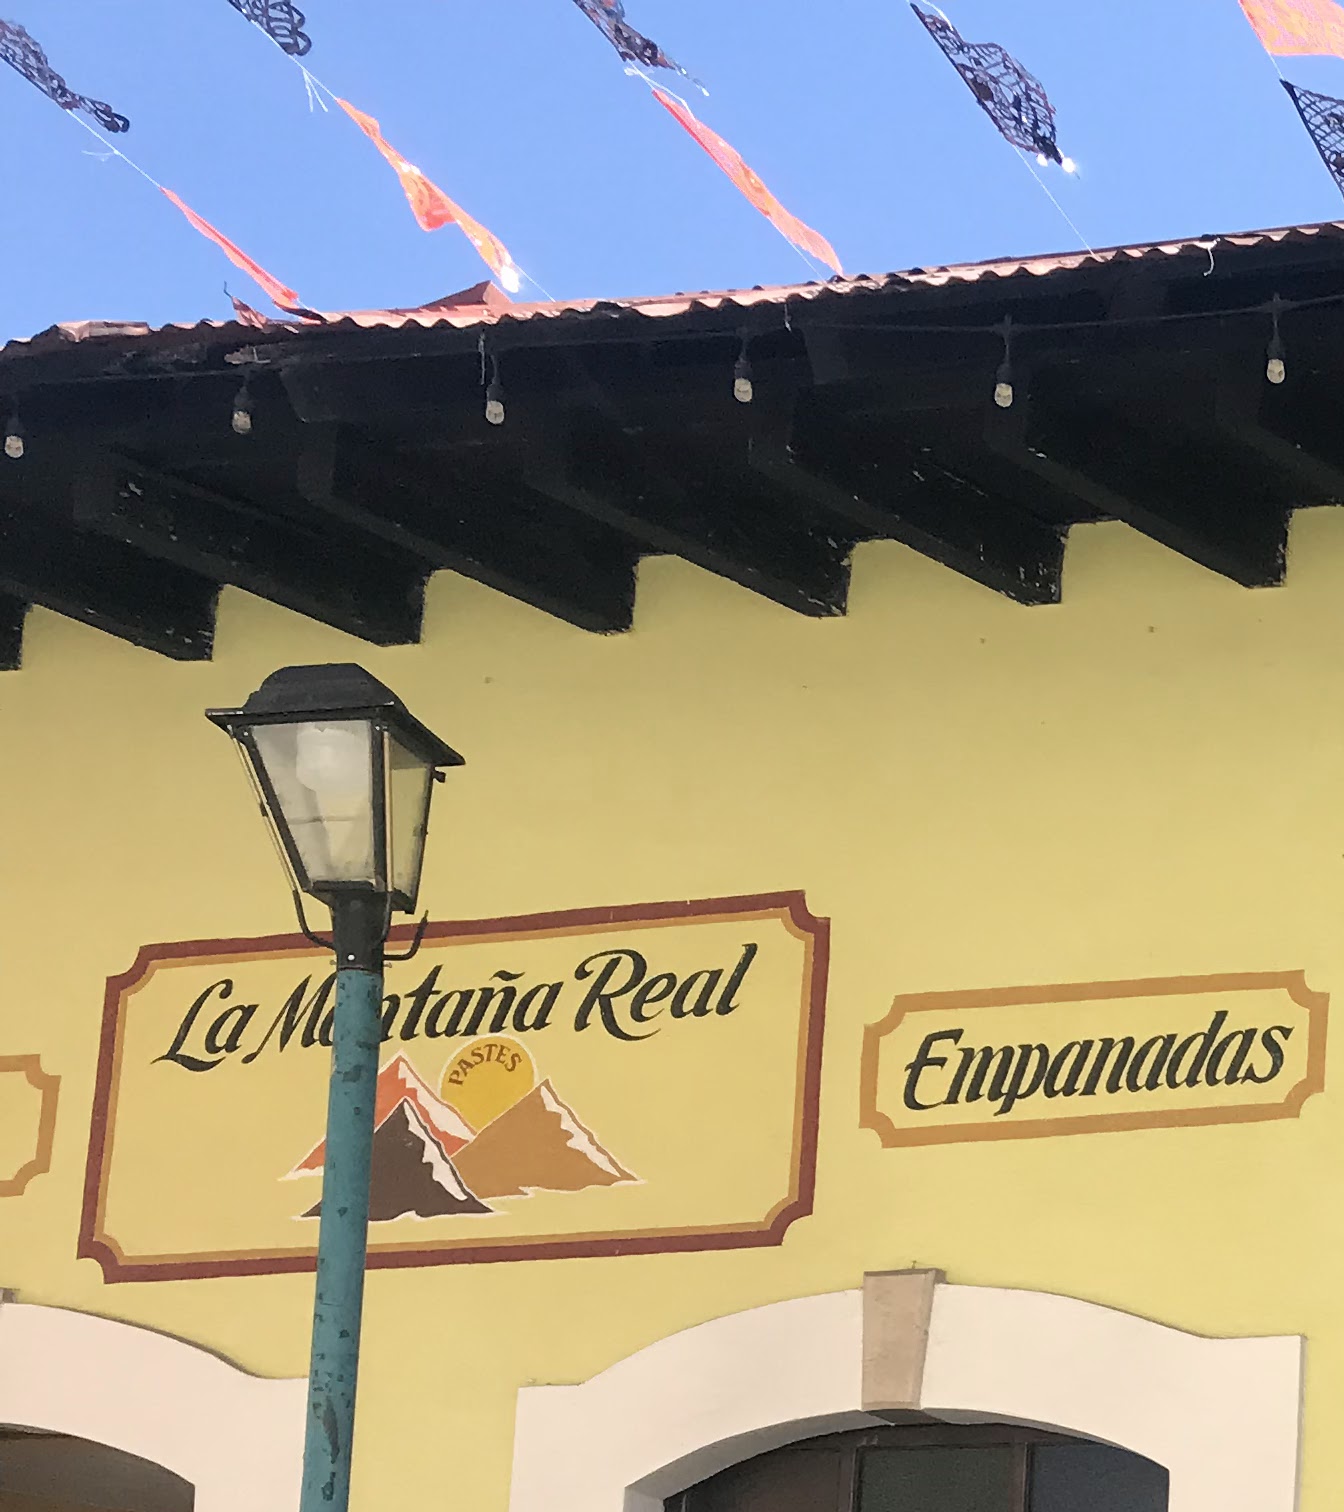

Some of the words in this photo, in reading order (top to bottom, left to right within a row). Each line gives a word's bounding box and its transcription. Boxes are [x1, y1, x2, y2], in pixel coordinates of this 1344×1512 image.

[151, 978, 253, 1073] La
[573, 942, 759, 1042] Real
[447, 1043, 523, 1088] PASTES
[903, 1009, 1296, 1117] Empanadas
